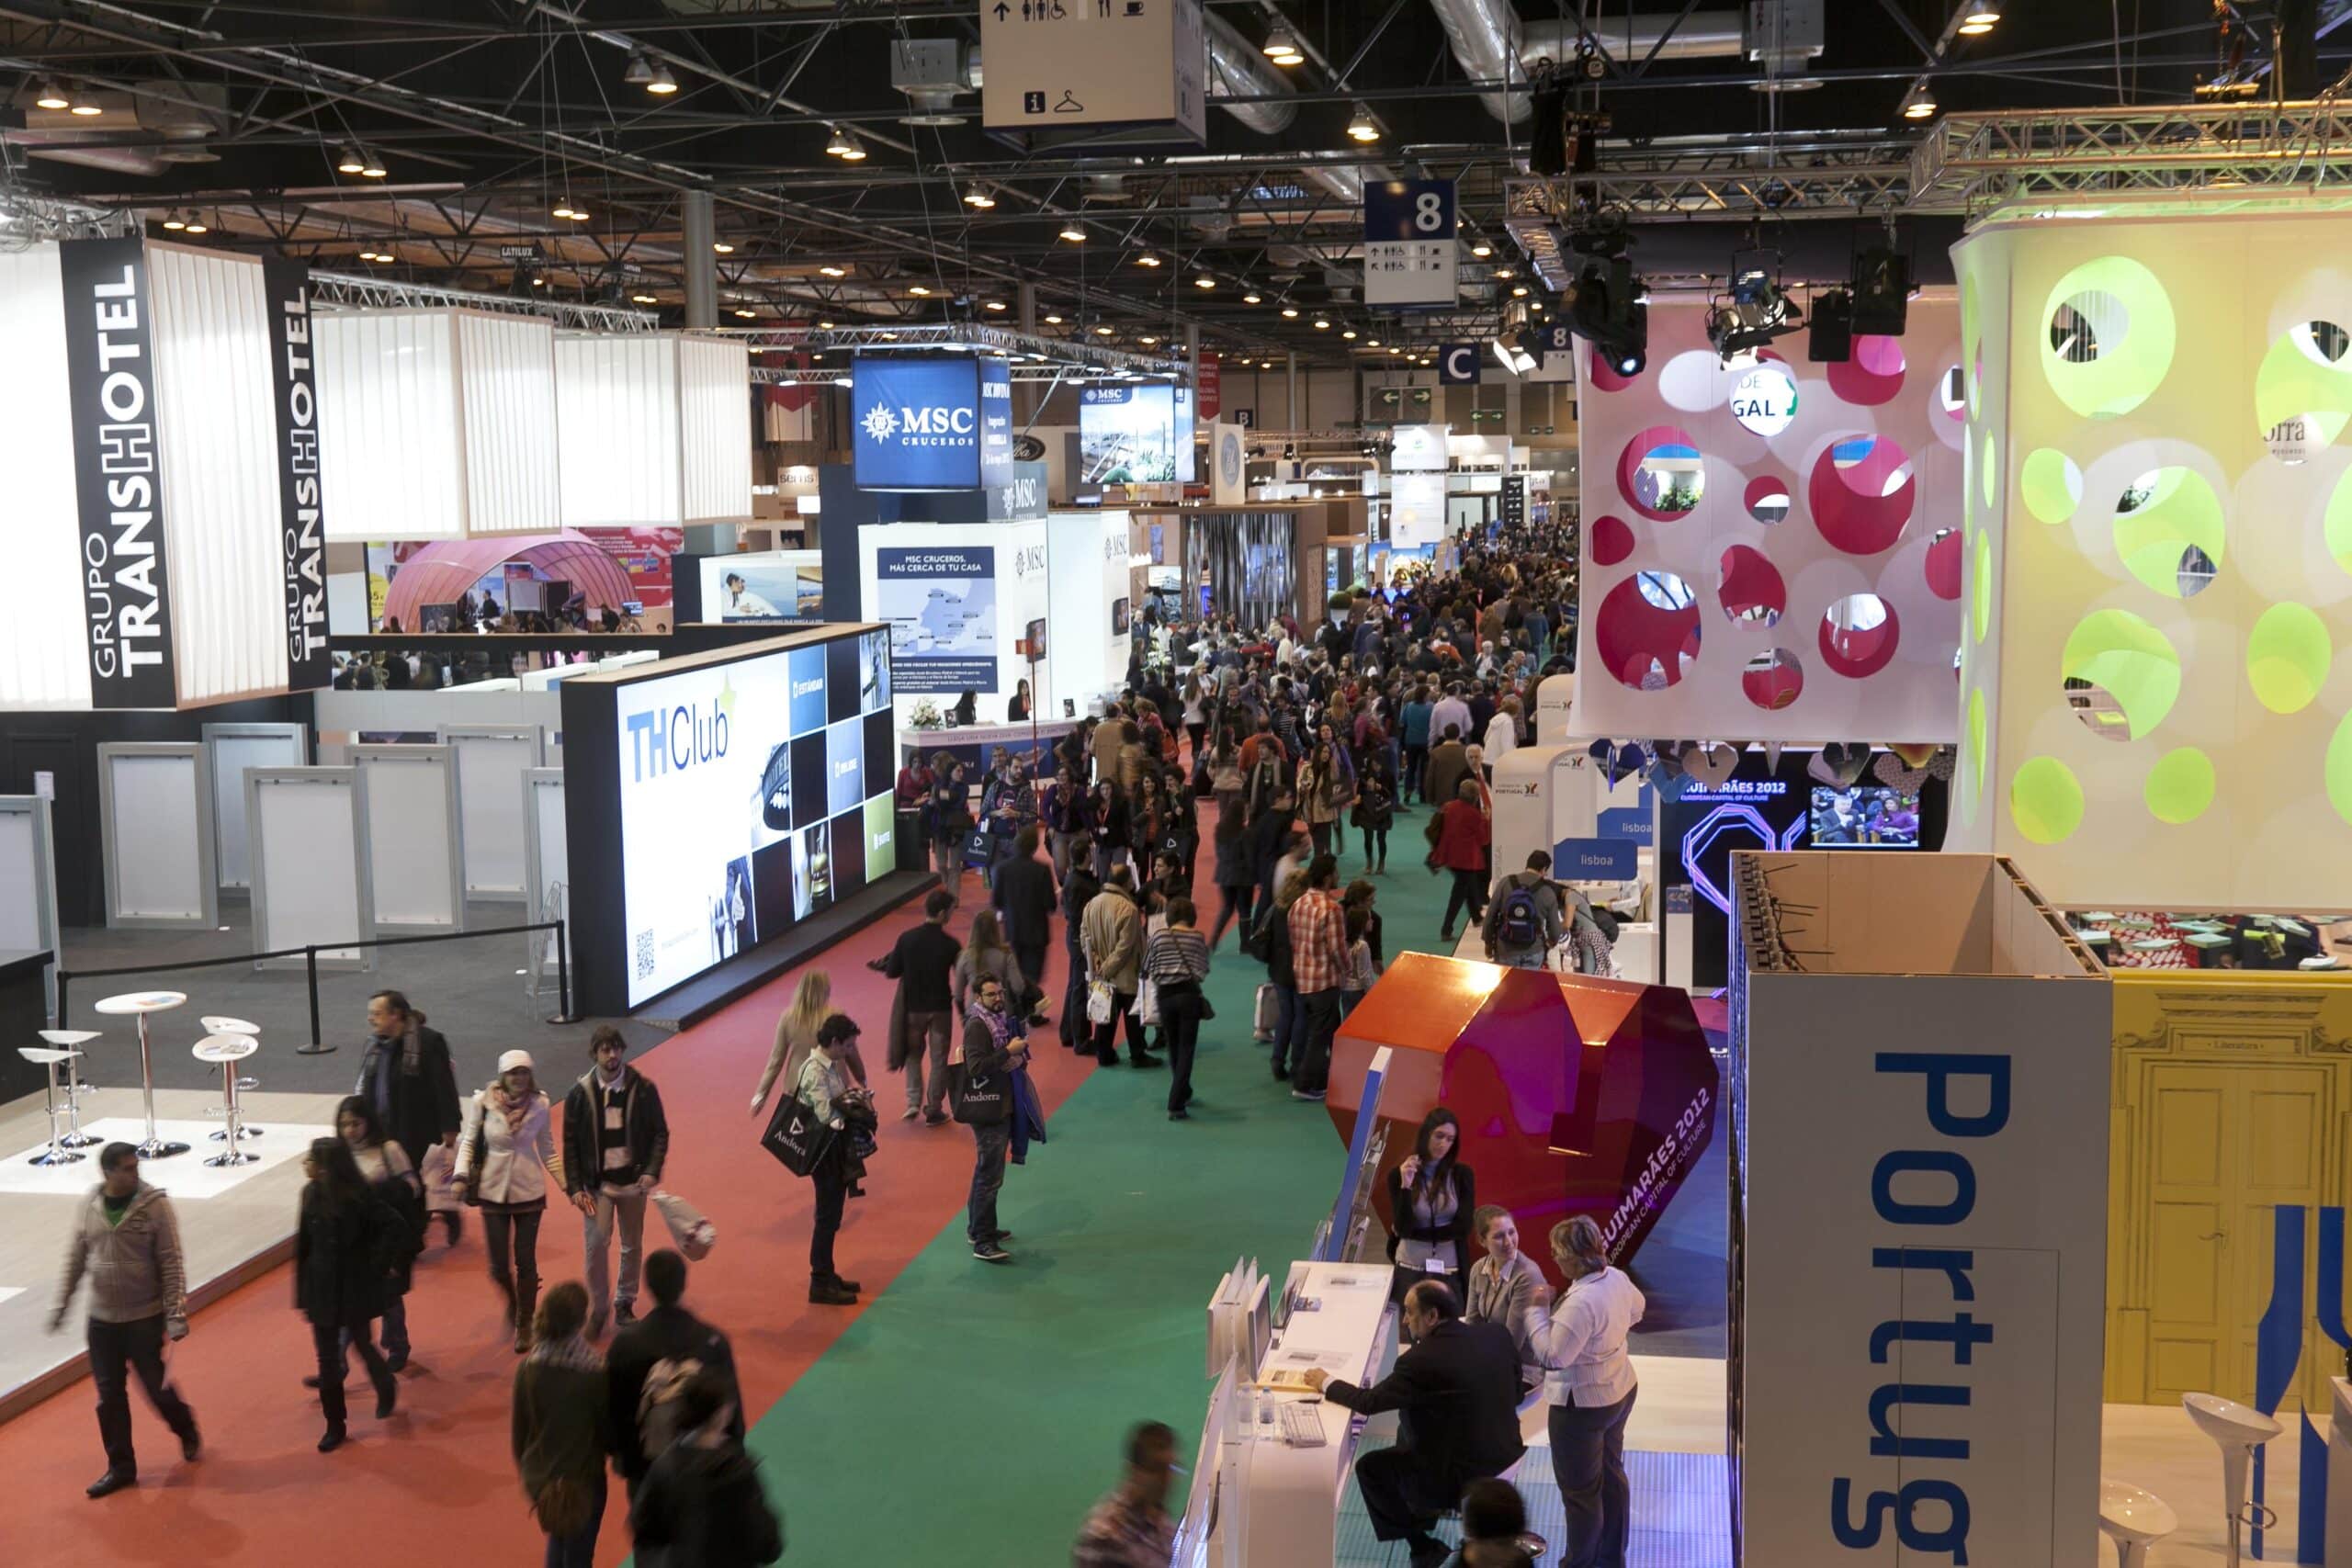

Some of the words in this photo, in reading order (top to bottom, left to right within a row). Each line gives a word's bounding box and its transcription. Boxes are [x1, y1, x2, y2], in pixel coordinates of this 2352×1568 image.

[1416, 192, 1442, 231] 8
[502, 247, 532, 257] LATILUX
[1553, 327, 1566, 347] 8
[1448, 348, 1472, 379] C
[1097, 389, 1123, 398] MSC
[901, 407, 974, 434] MSC
[1238, 412, 1249, 425] B
[902, 437, 974, 446] CRUCEROS
[95, 265, 163, 678] TRANSHOTEL
[285, 286, 326, 660] TRANSHOTEL
[1015, 479, 1036, 508] MSC
[889, 563, 906, 572] MÁS
[907, 564, 933, 572] CERCA
[948, 563, 959, 571] TU
[961, 563, 982, 571] CASA
[905, 555, 922, 564] MSC
[923, 555, 966, 563] CRUCEROS.
[1026, 546, 1045, 571] MSC
[85, 532, 117, 678] GRUPO
[285, 527, 301, 662] GRUPO
[1686, 779, 1753, 793] UIRÃES
[1756, 783, 1786, 794] 2012
[1623, 823, 1652, 832] lisboa
[1581, 855, 1613, 865] lisboa
[963, 1091, 1001, 1102] Andorra
[1675, 1088, 1710, 1139] 2012
[1640, 1178, 1668, 1217] CAPITAL
[1667, 1161, 1677, 1178] OF
[1677, 1119, 1707, 1164] CULTURE
[1831, 1052, 2012, 1567] Portug
